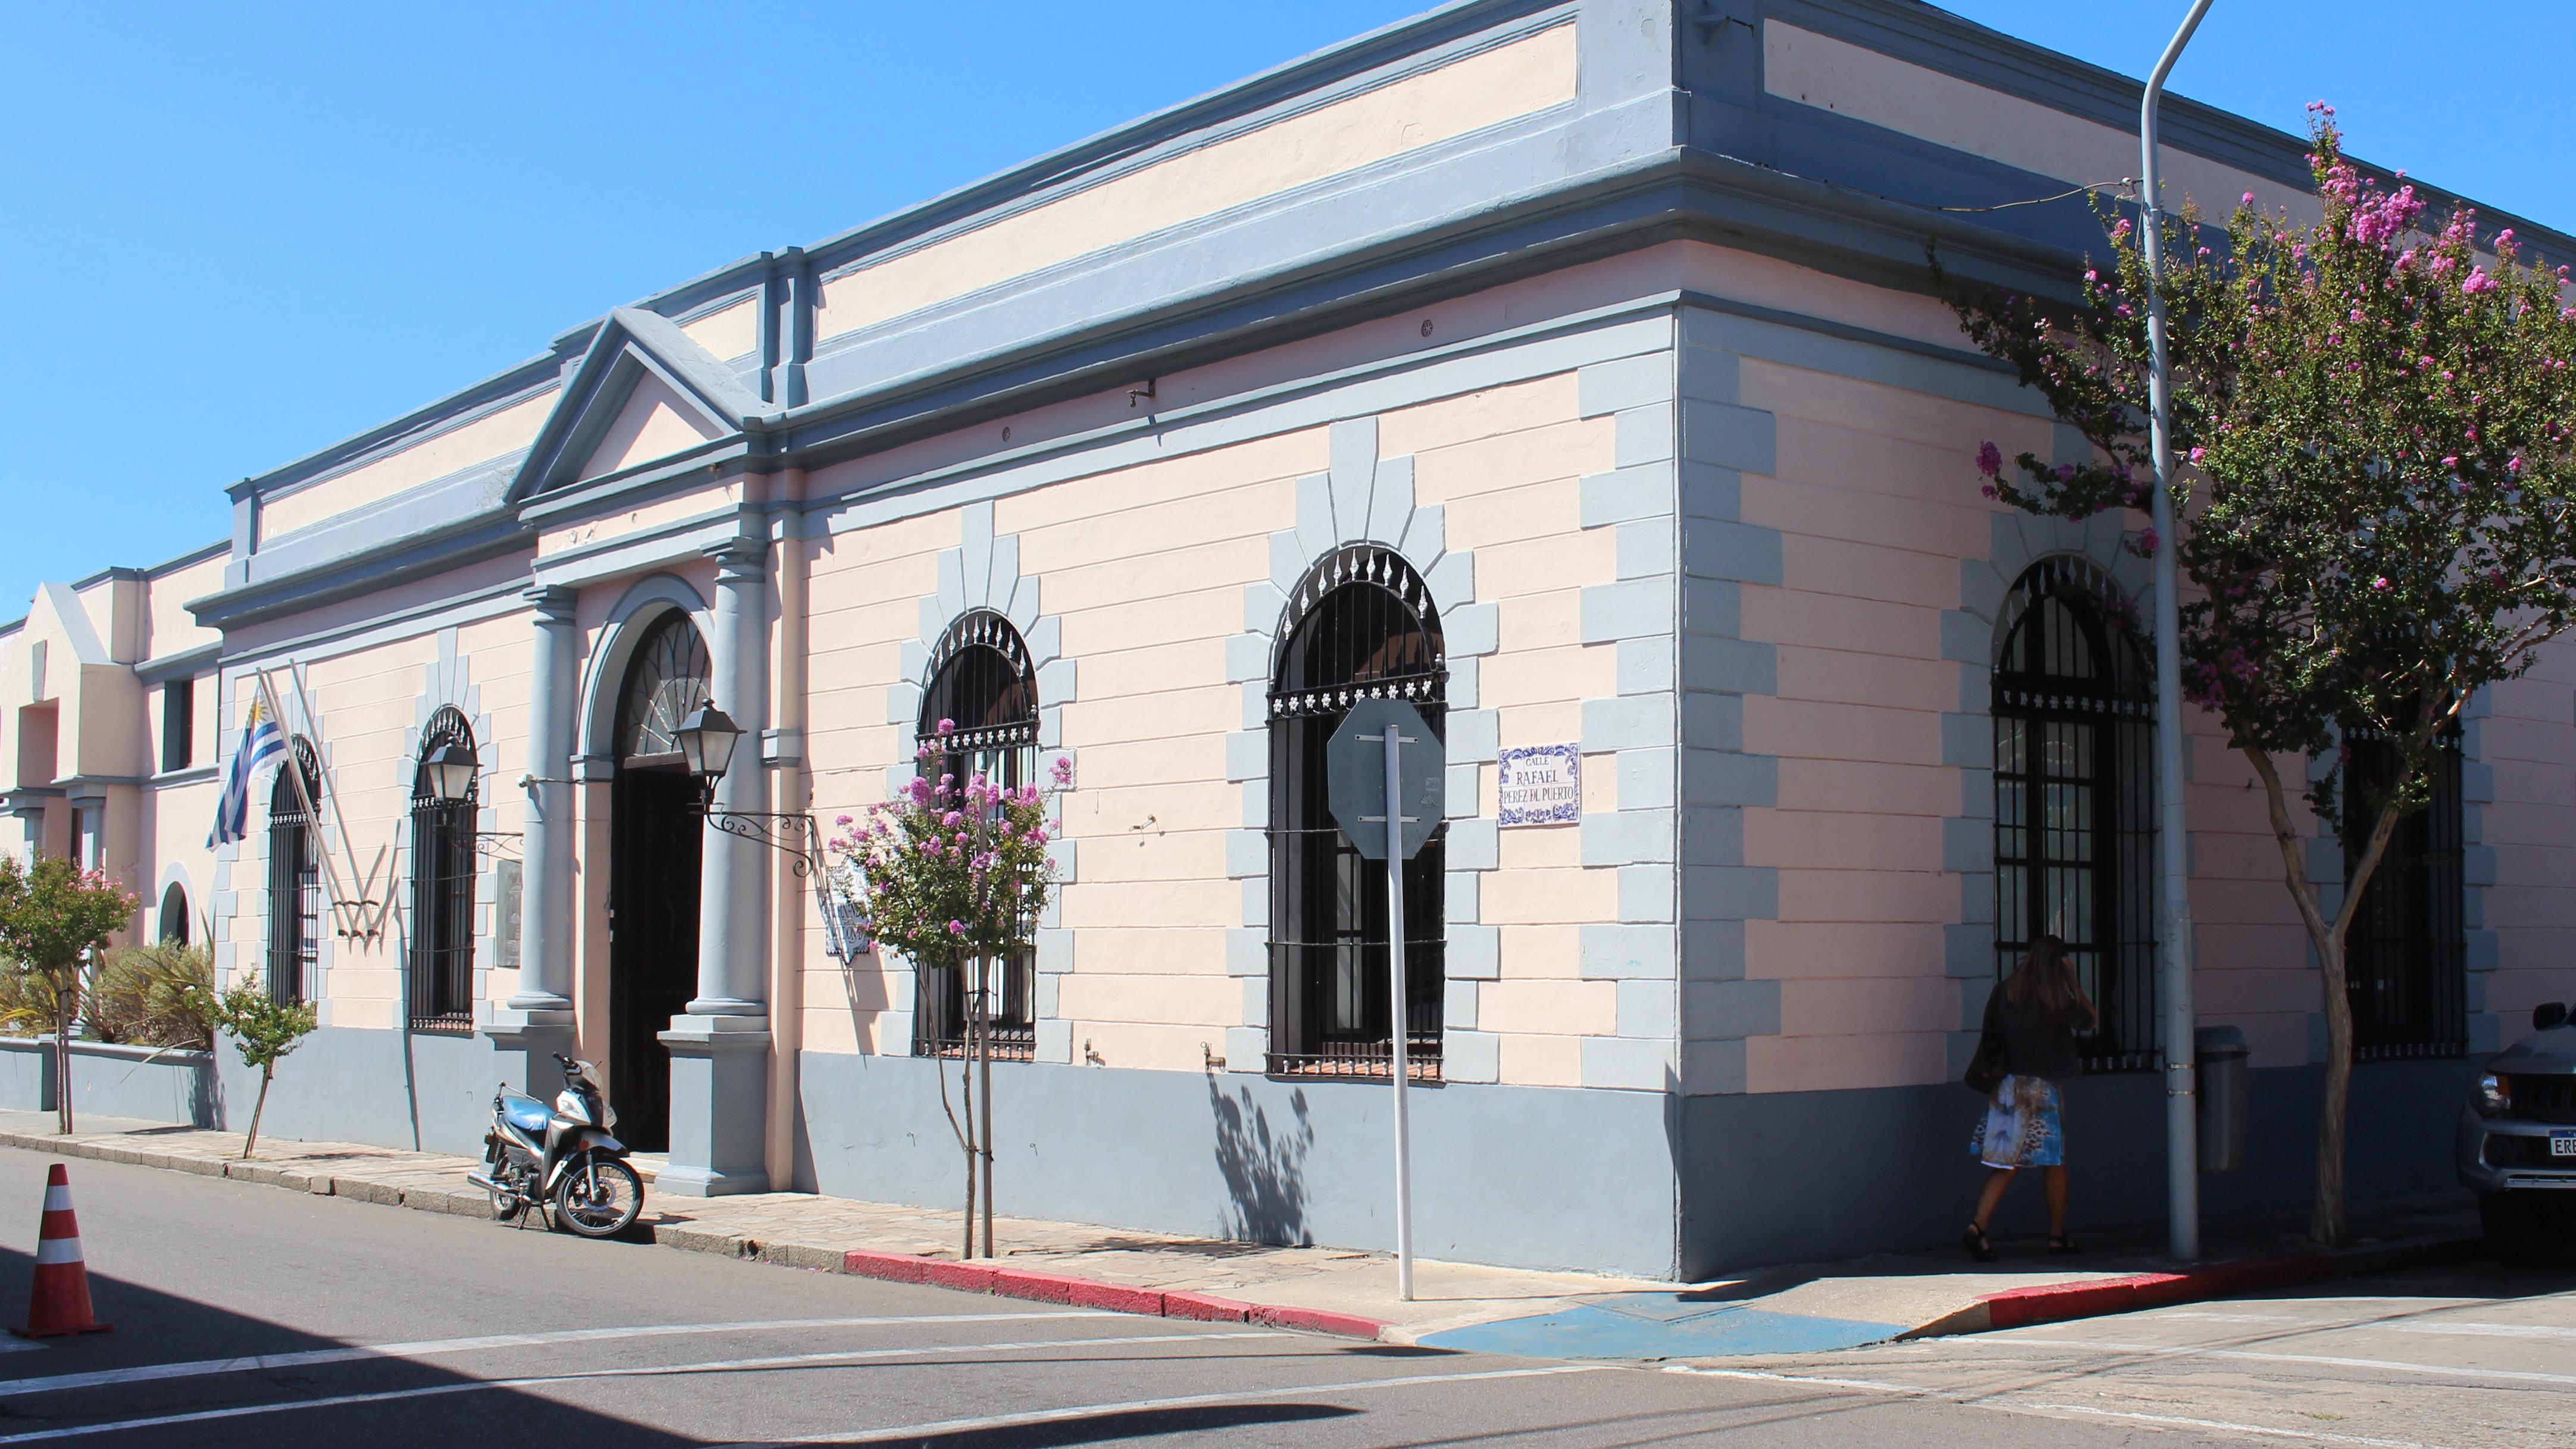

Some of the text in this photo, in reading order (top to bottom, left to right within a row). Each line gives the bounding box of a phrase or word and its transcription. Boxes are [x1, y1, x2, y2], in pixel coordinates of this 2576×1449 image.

[1526, 756, 1549, 766] CALLE
[1516, 769, 1558, 785] RAFAEL
[1504, 789, 1528, 804] PEREZ
[1542, 786, 1574, 801] PUERTO
